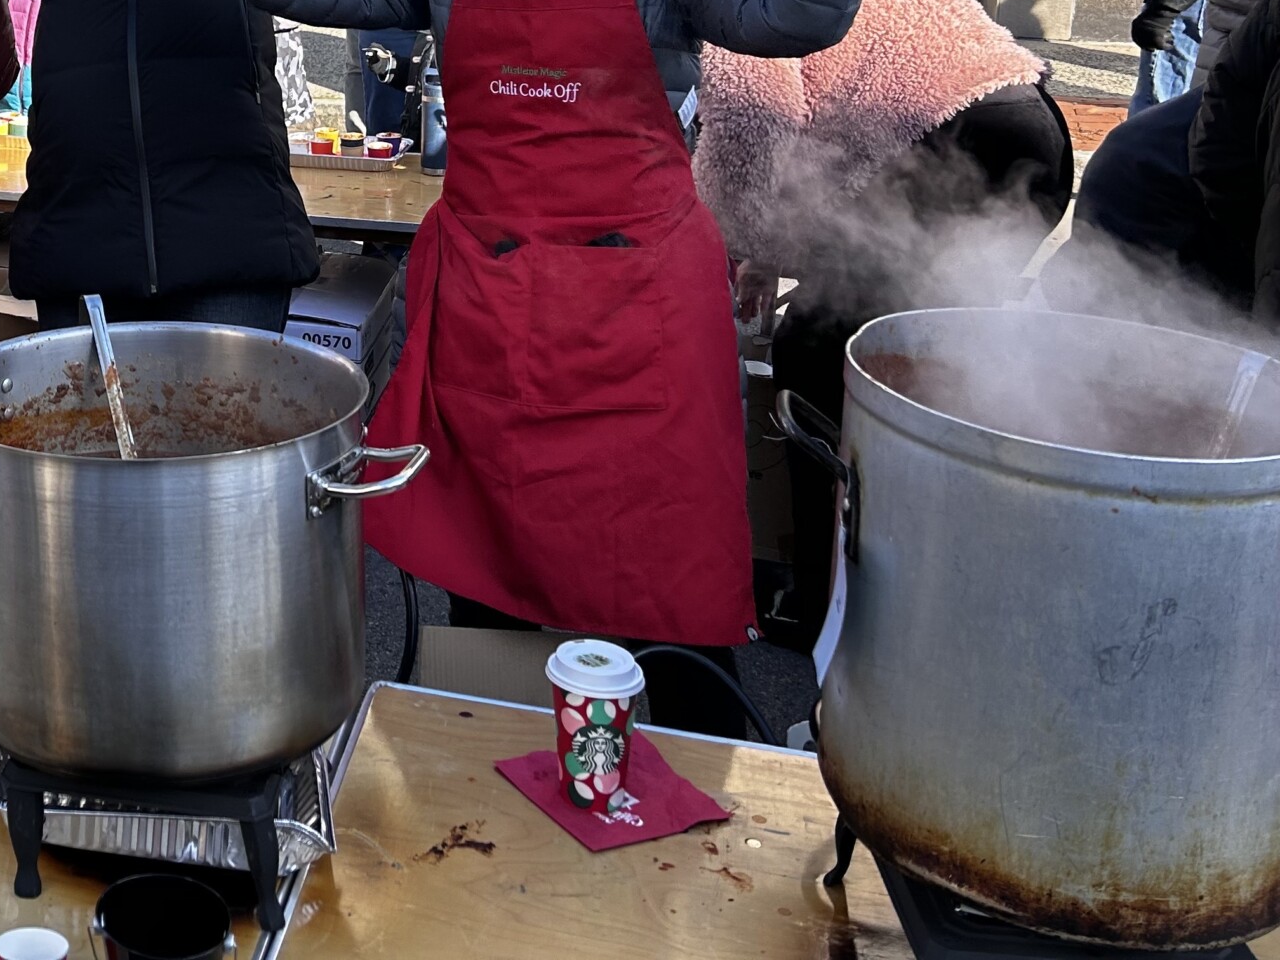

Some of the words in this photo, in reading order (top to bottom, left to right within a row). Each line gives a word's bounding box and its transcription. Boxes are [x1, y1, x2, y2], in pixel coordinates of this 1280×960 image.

[489, 79, 518, 96] Chili
[519, 82, 552, 98] Cook
[554, 82, 582, 103] Off
[302, 332, 352, 350] 00570
